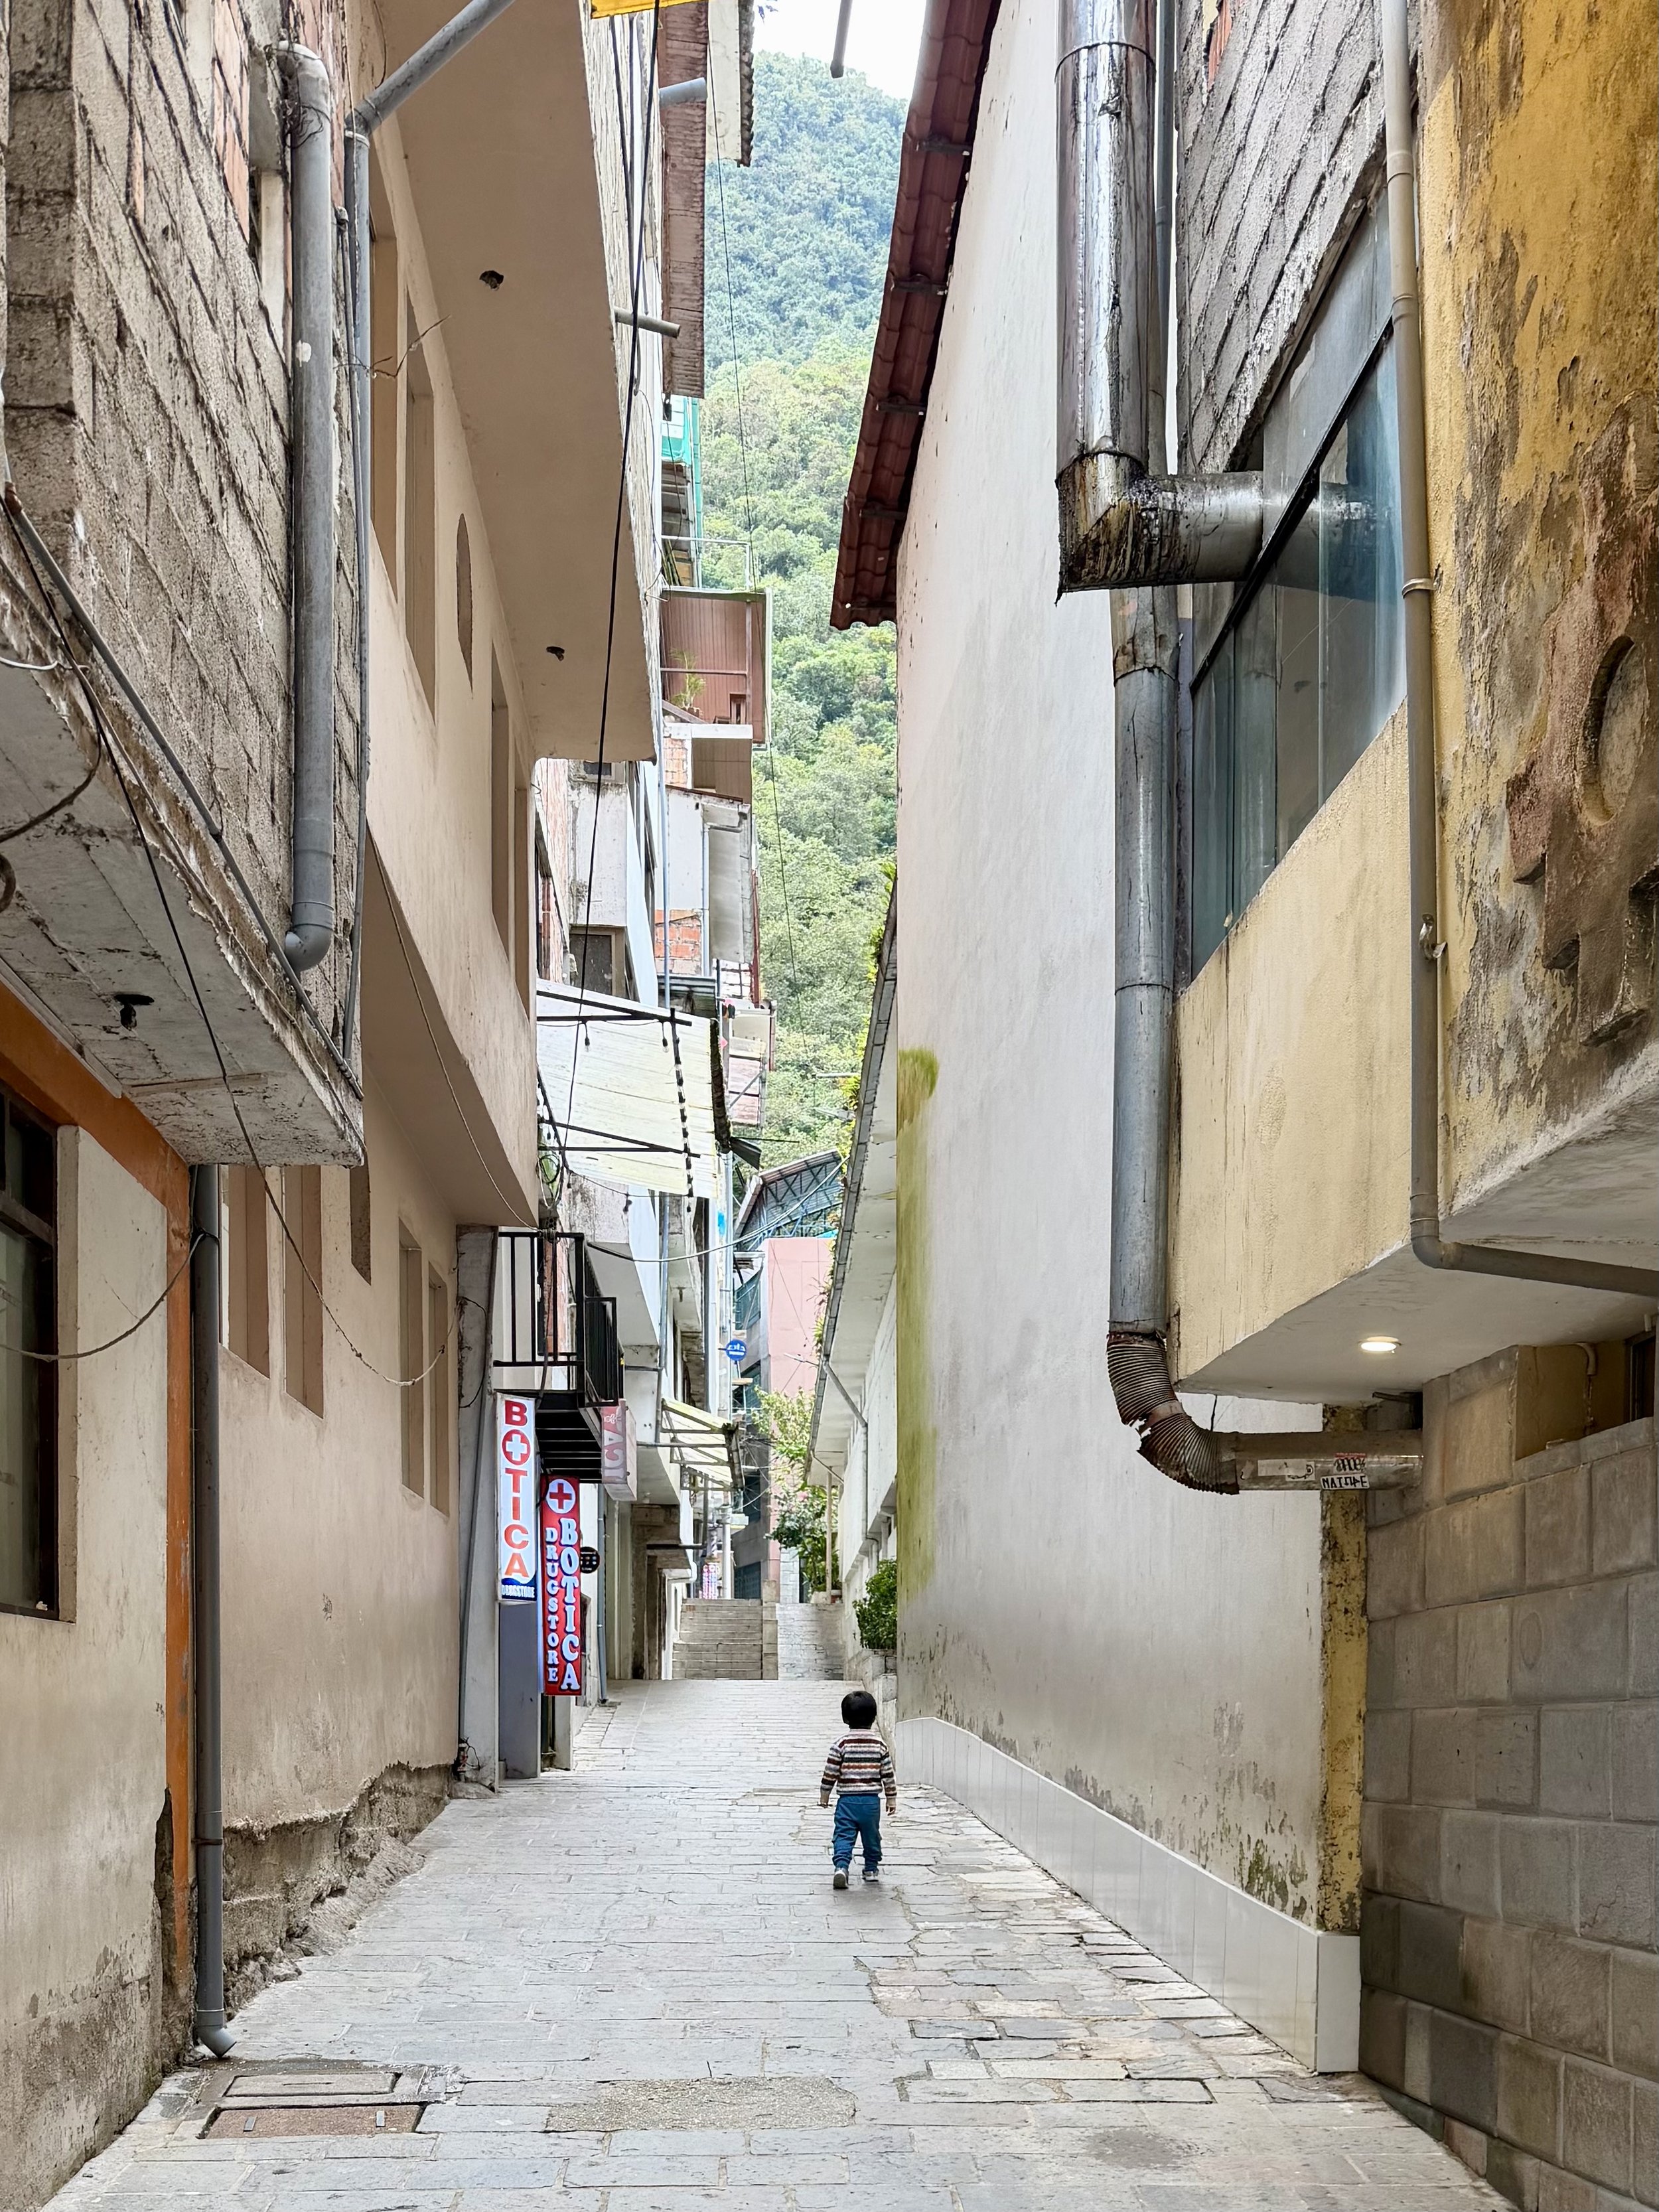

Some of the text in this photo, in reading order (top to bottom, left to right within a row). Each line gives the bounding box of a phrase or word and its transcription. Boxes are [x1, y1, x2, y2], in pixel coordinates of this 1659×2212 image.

[502, 1399, 530, 1578] BOTICA
[545, 1527, 559, 1682] DRUGSTORE
[559, 1517, 580, 1690] BOTICA
